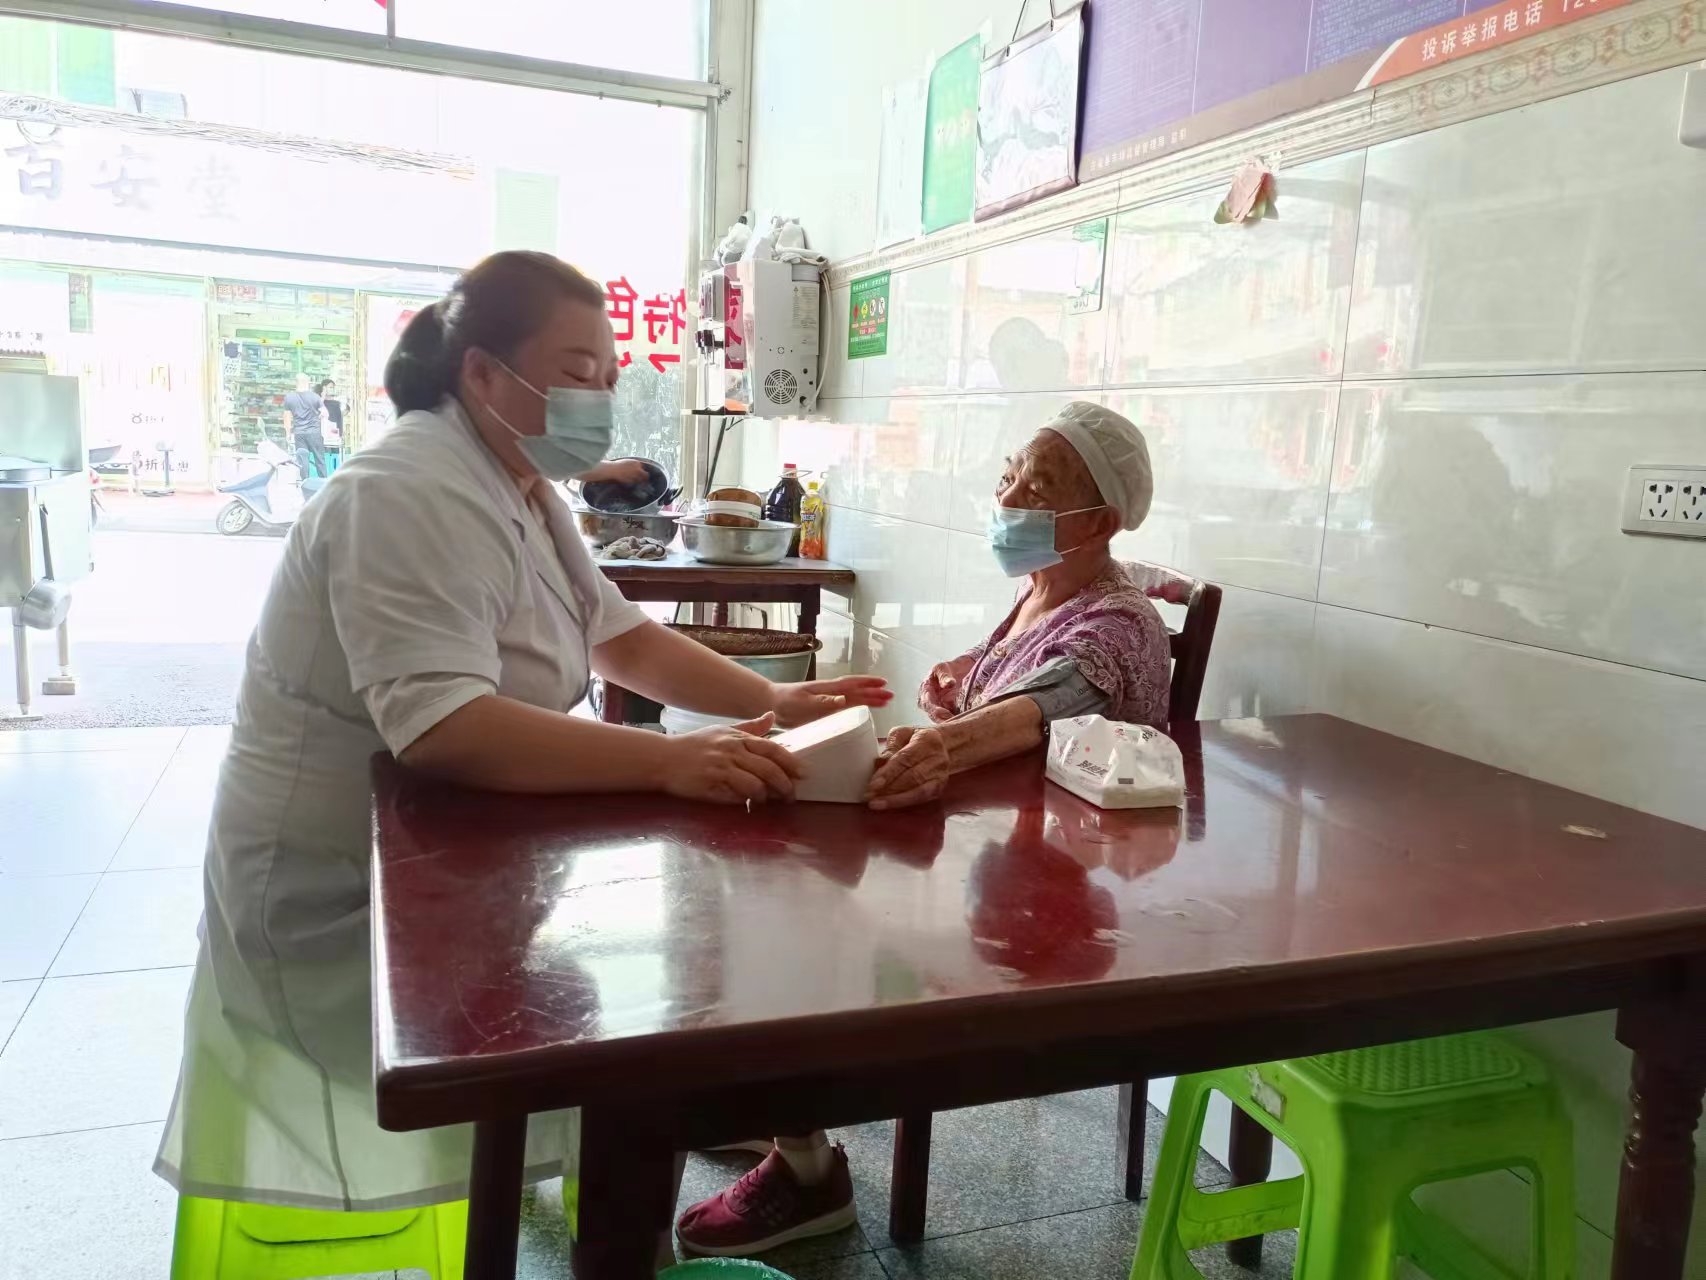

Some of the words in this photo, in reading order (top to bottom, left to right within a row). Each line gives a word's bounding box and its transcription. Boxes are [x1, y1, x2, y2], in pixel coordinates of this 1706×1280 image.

[1422, 2, 1543, 62] 投诉举报电话
